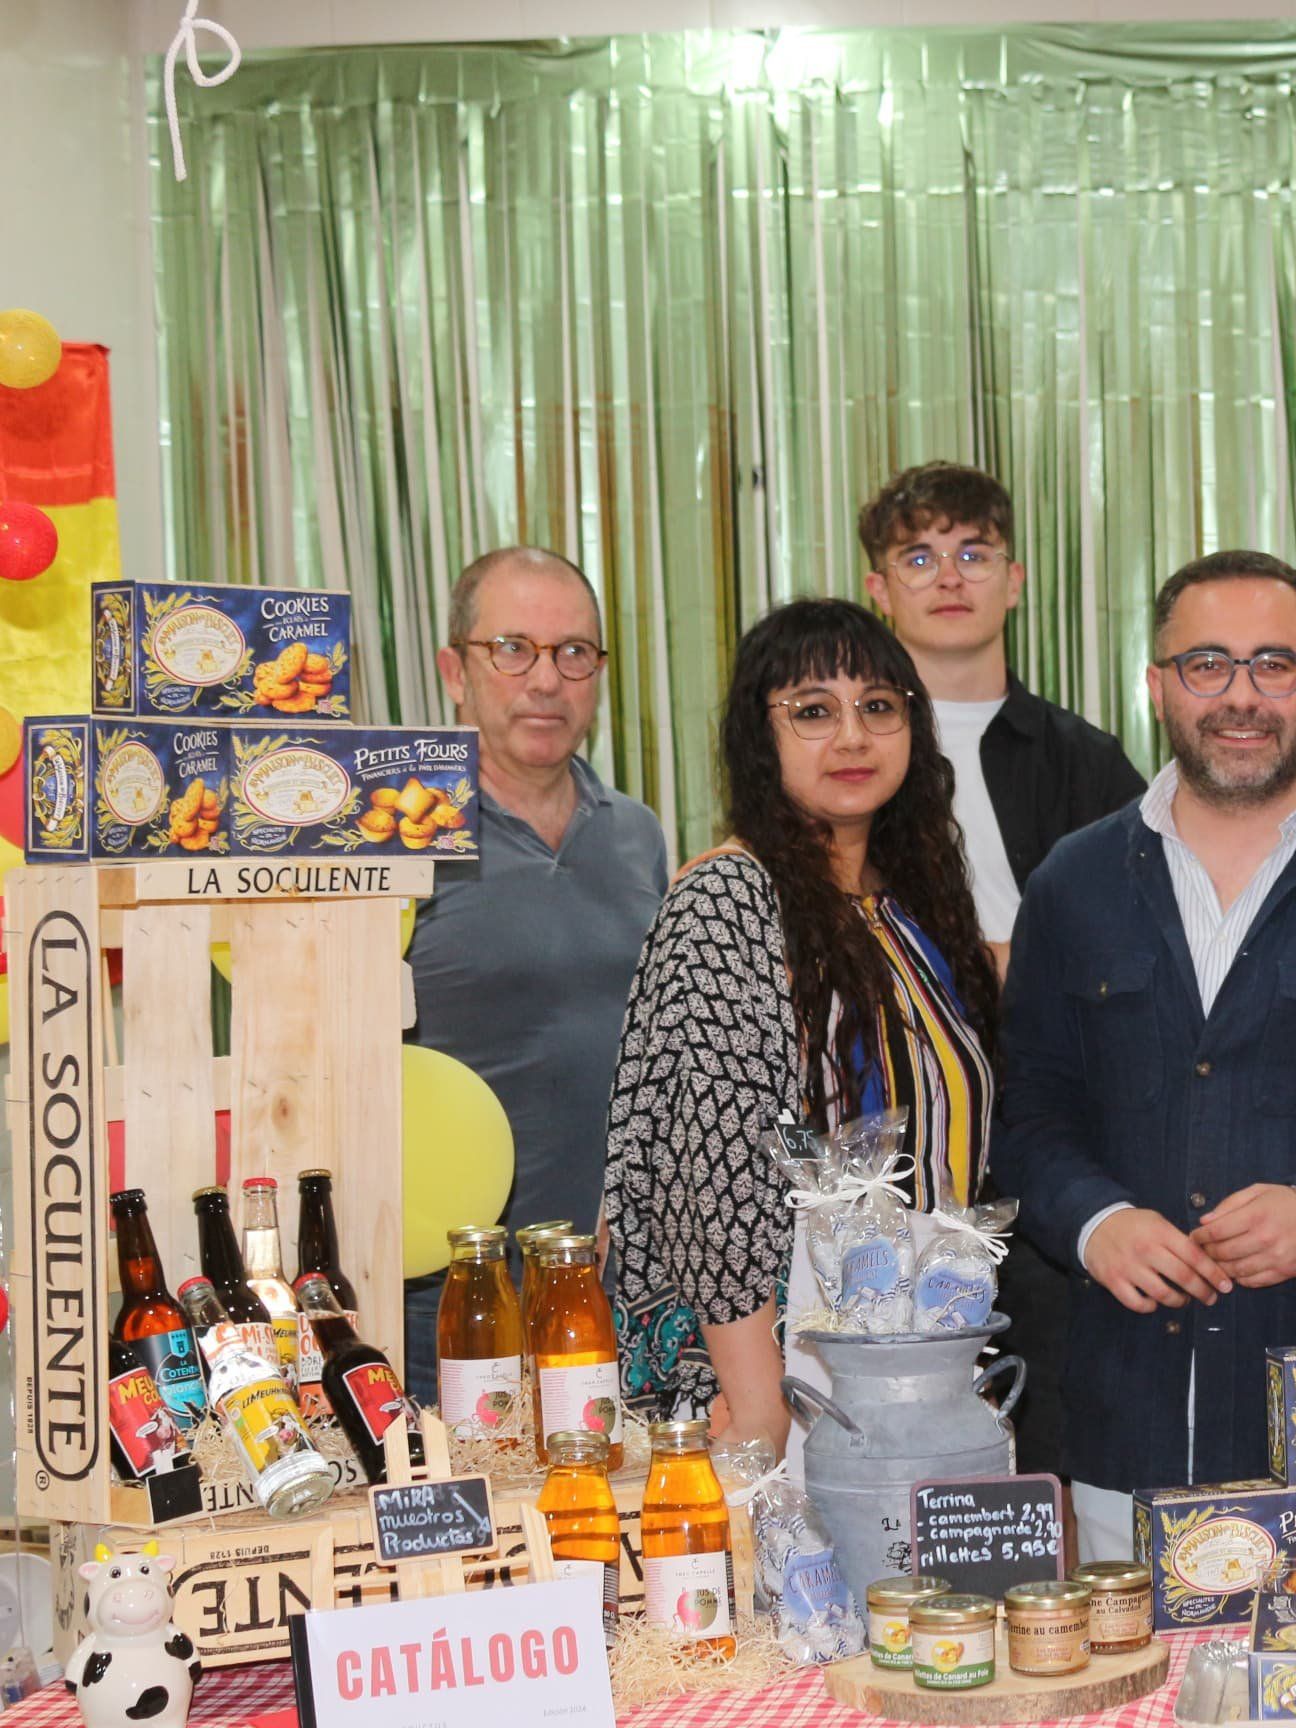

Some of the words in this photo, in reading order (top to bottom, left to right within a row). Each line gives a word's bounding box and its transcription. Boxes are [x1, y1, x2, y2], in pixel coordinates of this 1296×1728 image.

[261, 597, 329, 619] COOKIES
[269, 622, 328, 642] CARAMEL
[174, 731, 218, 755] COOKIES
[354, 745, 410, 770] PETITS
[414, 738, 468, 762] FOURS
[179, 758, 217, 778] CARAMEL
[188, 868, 221, 894] LA
[237, 867, 391, 893] SOCULENTE
[41, 937, 79, 1024] LA
[42, 1052, 87, 1455] SOCULENTE
[117, 1374, 156, 1405] MEU
[917, 1488, 976, 1509] Terrina
[929, 1504, 1015, 1526] camembert
[1021, 1503, 1054, 1522] 2,99
[1035, 1520, 1062, 1538] 2,90
[920, 1544, 993, 1567] rillettes
[1033, 1625, 1045, 1636] au
[336, 1625, 579, 1701] CATÁLOGO
